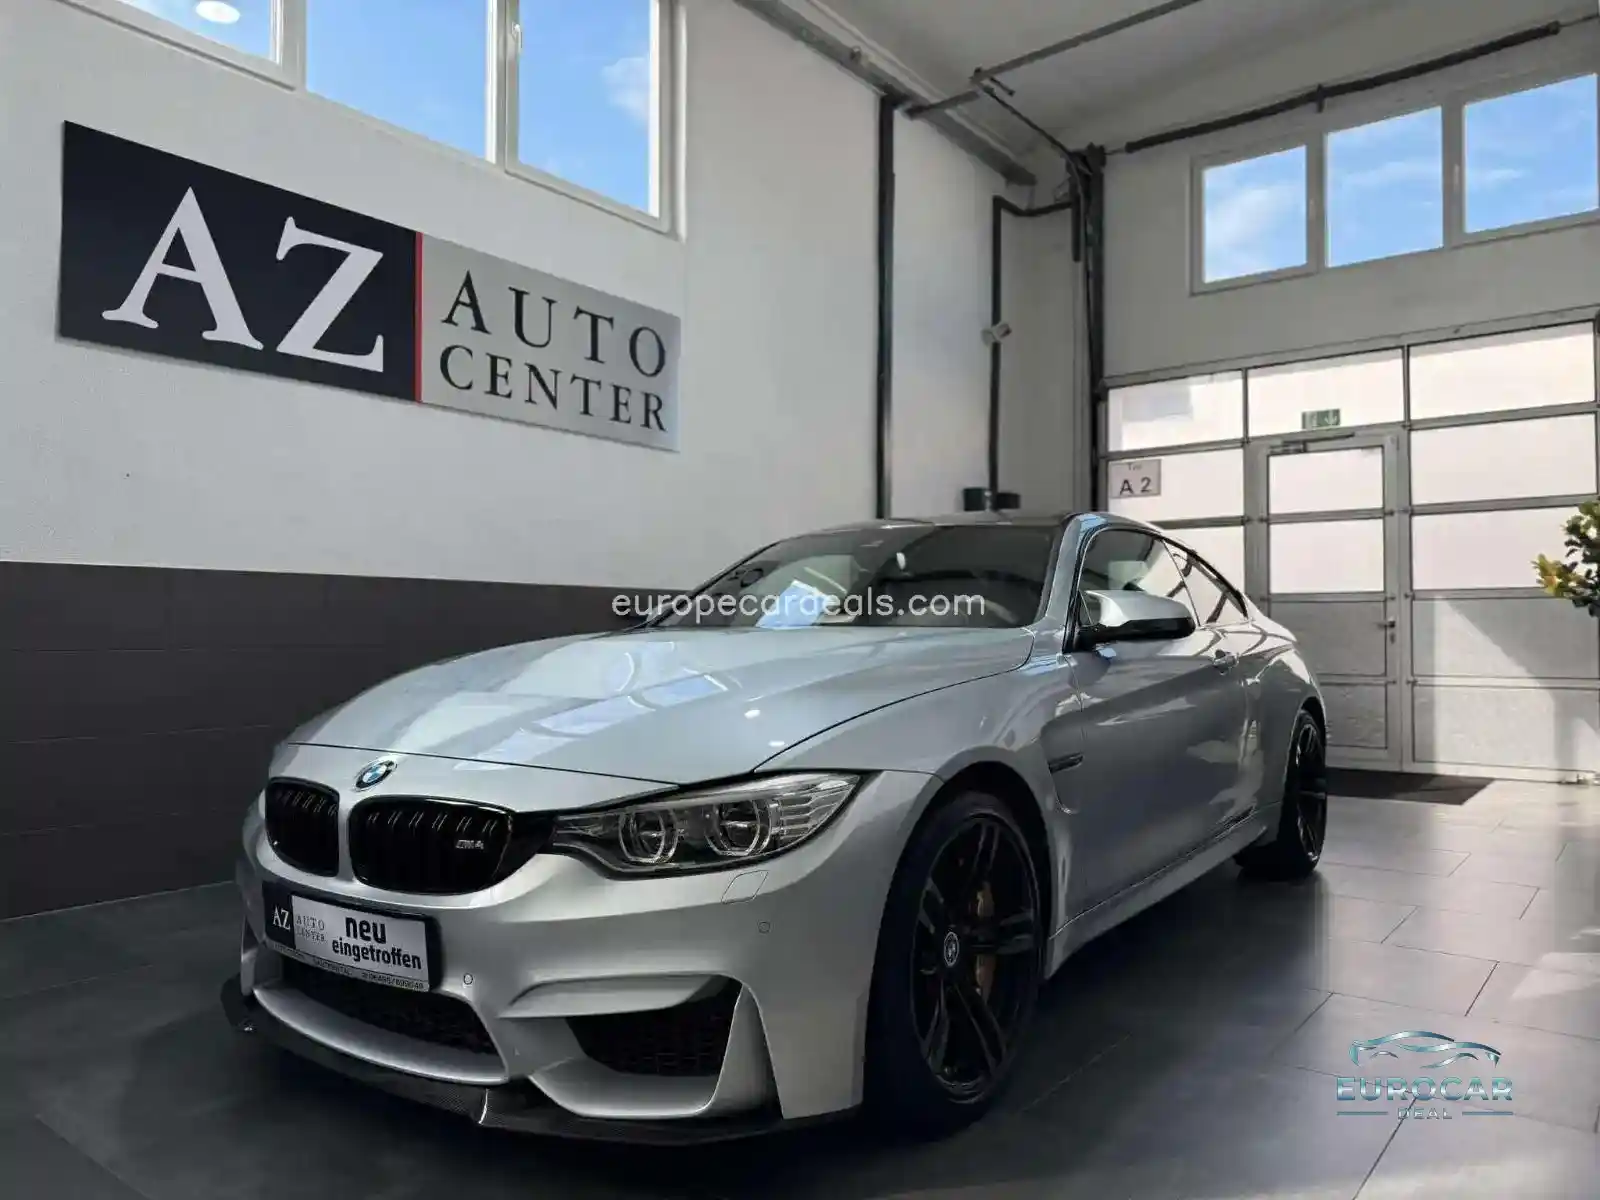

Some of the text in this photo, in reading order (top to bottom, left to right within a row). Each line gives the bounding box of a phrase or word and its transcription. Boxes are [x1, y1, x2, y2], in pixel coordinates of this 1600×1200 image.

[102, 187, 384, 373] AZ
[441, 270, 667, 378] AUTO
[439, 344, 668, 433] CENTER
[1119, 476, 1153, 495] A 2
[272, 905, 291, 930] AZ
[345, 917, 387, 944] neu
[332, 936, 422, 970] eingetroffen
